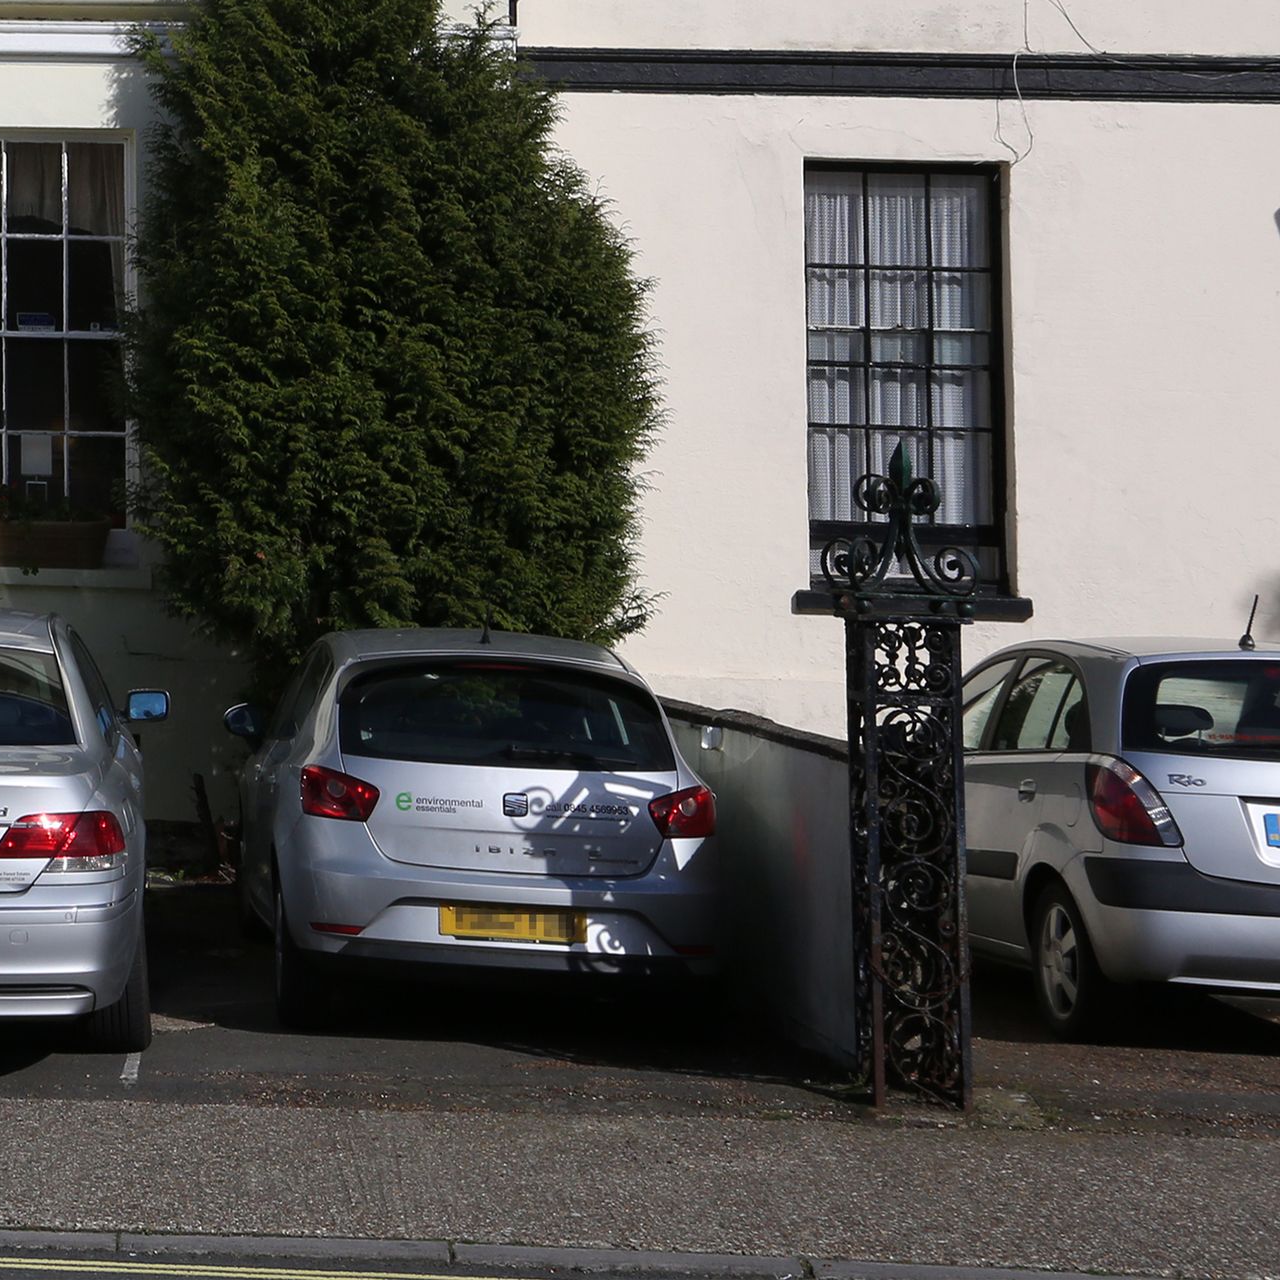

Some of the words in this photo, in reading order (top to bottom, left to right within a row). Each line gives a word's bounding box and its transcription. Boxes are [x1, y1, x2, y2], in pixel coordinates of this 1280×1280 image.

[1167, 773, 1207, 788] Rio
[416, 796, 483, 808] environmental
[416, 805, 457, 814] essentials
[545, 803, 561, 812] call
